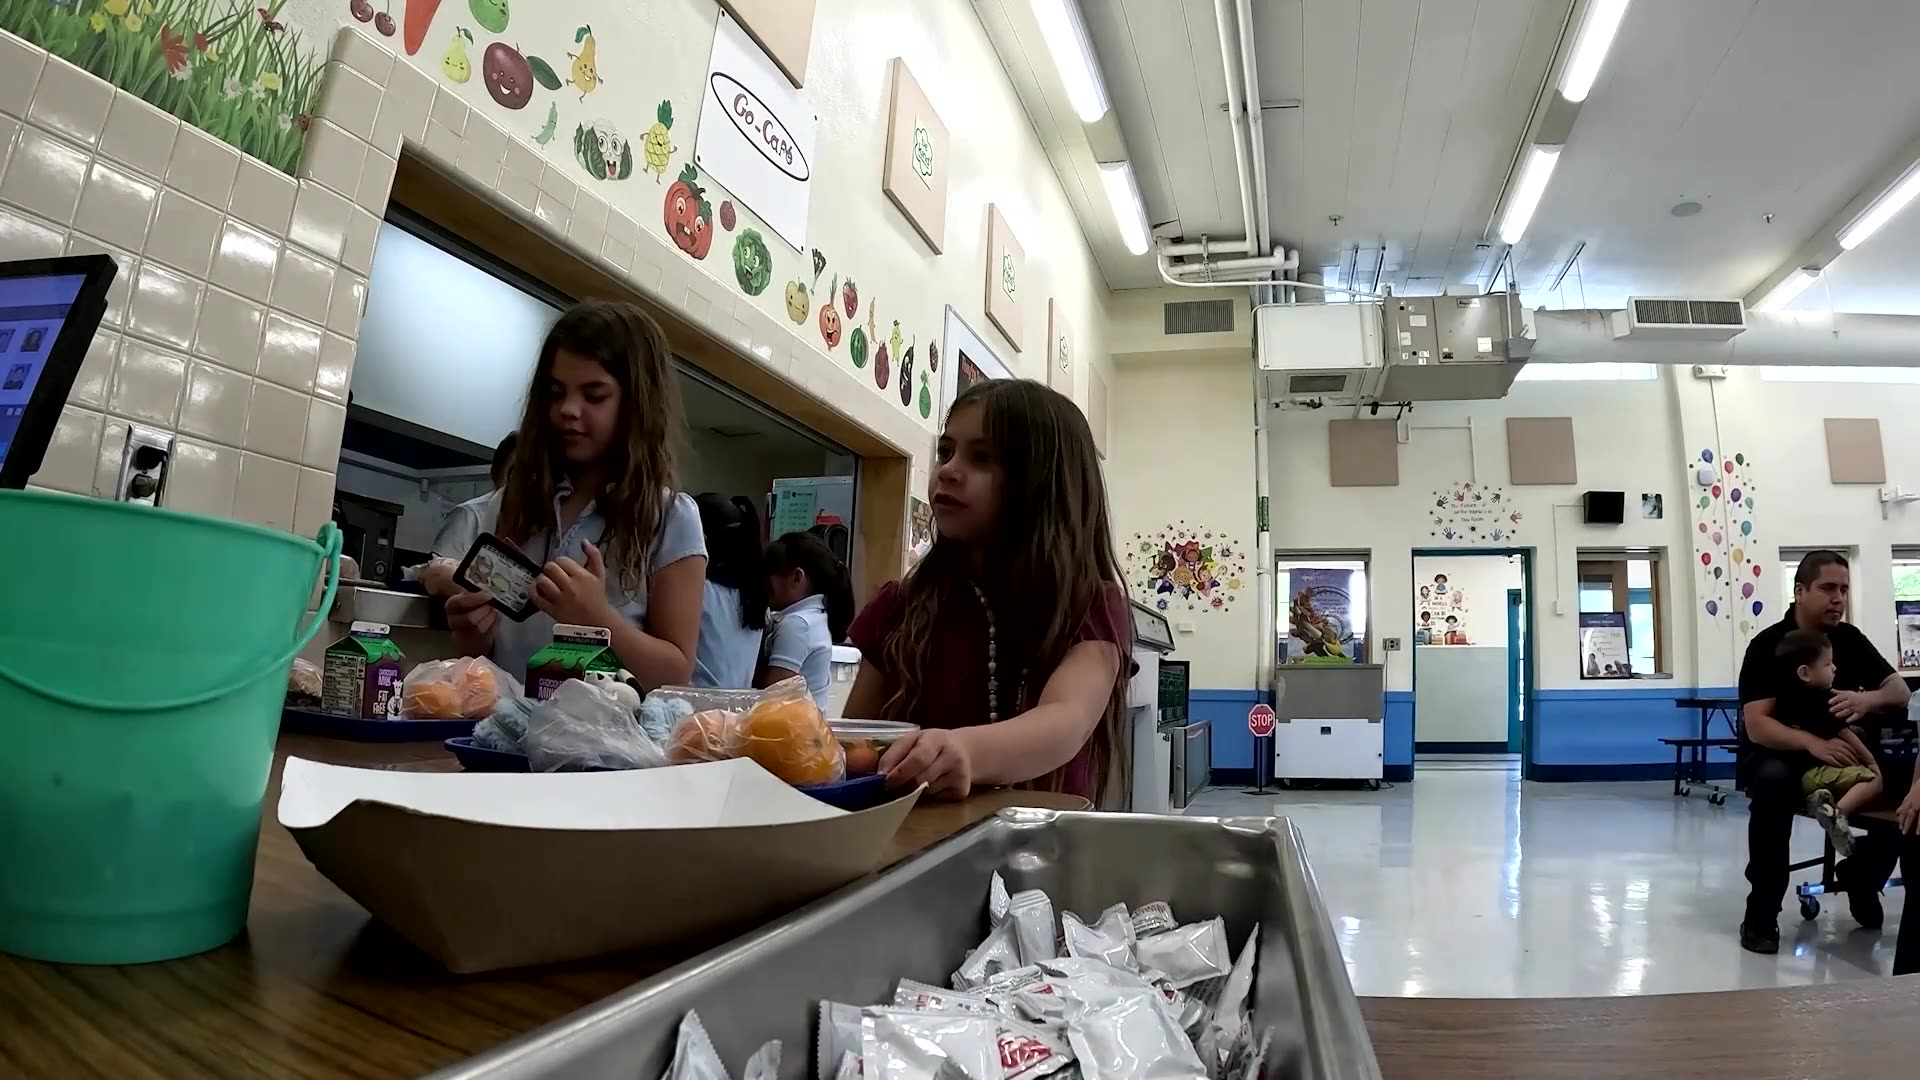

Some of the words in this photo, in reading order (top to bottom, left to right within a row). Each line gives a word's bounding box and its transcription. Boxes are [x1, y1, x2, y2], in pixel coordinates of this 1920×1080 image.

[378, 690, 389, 703] FAT
[373, 702, 386, 715] FREE
[1251, 713, 1273, 727] STOP
